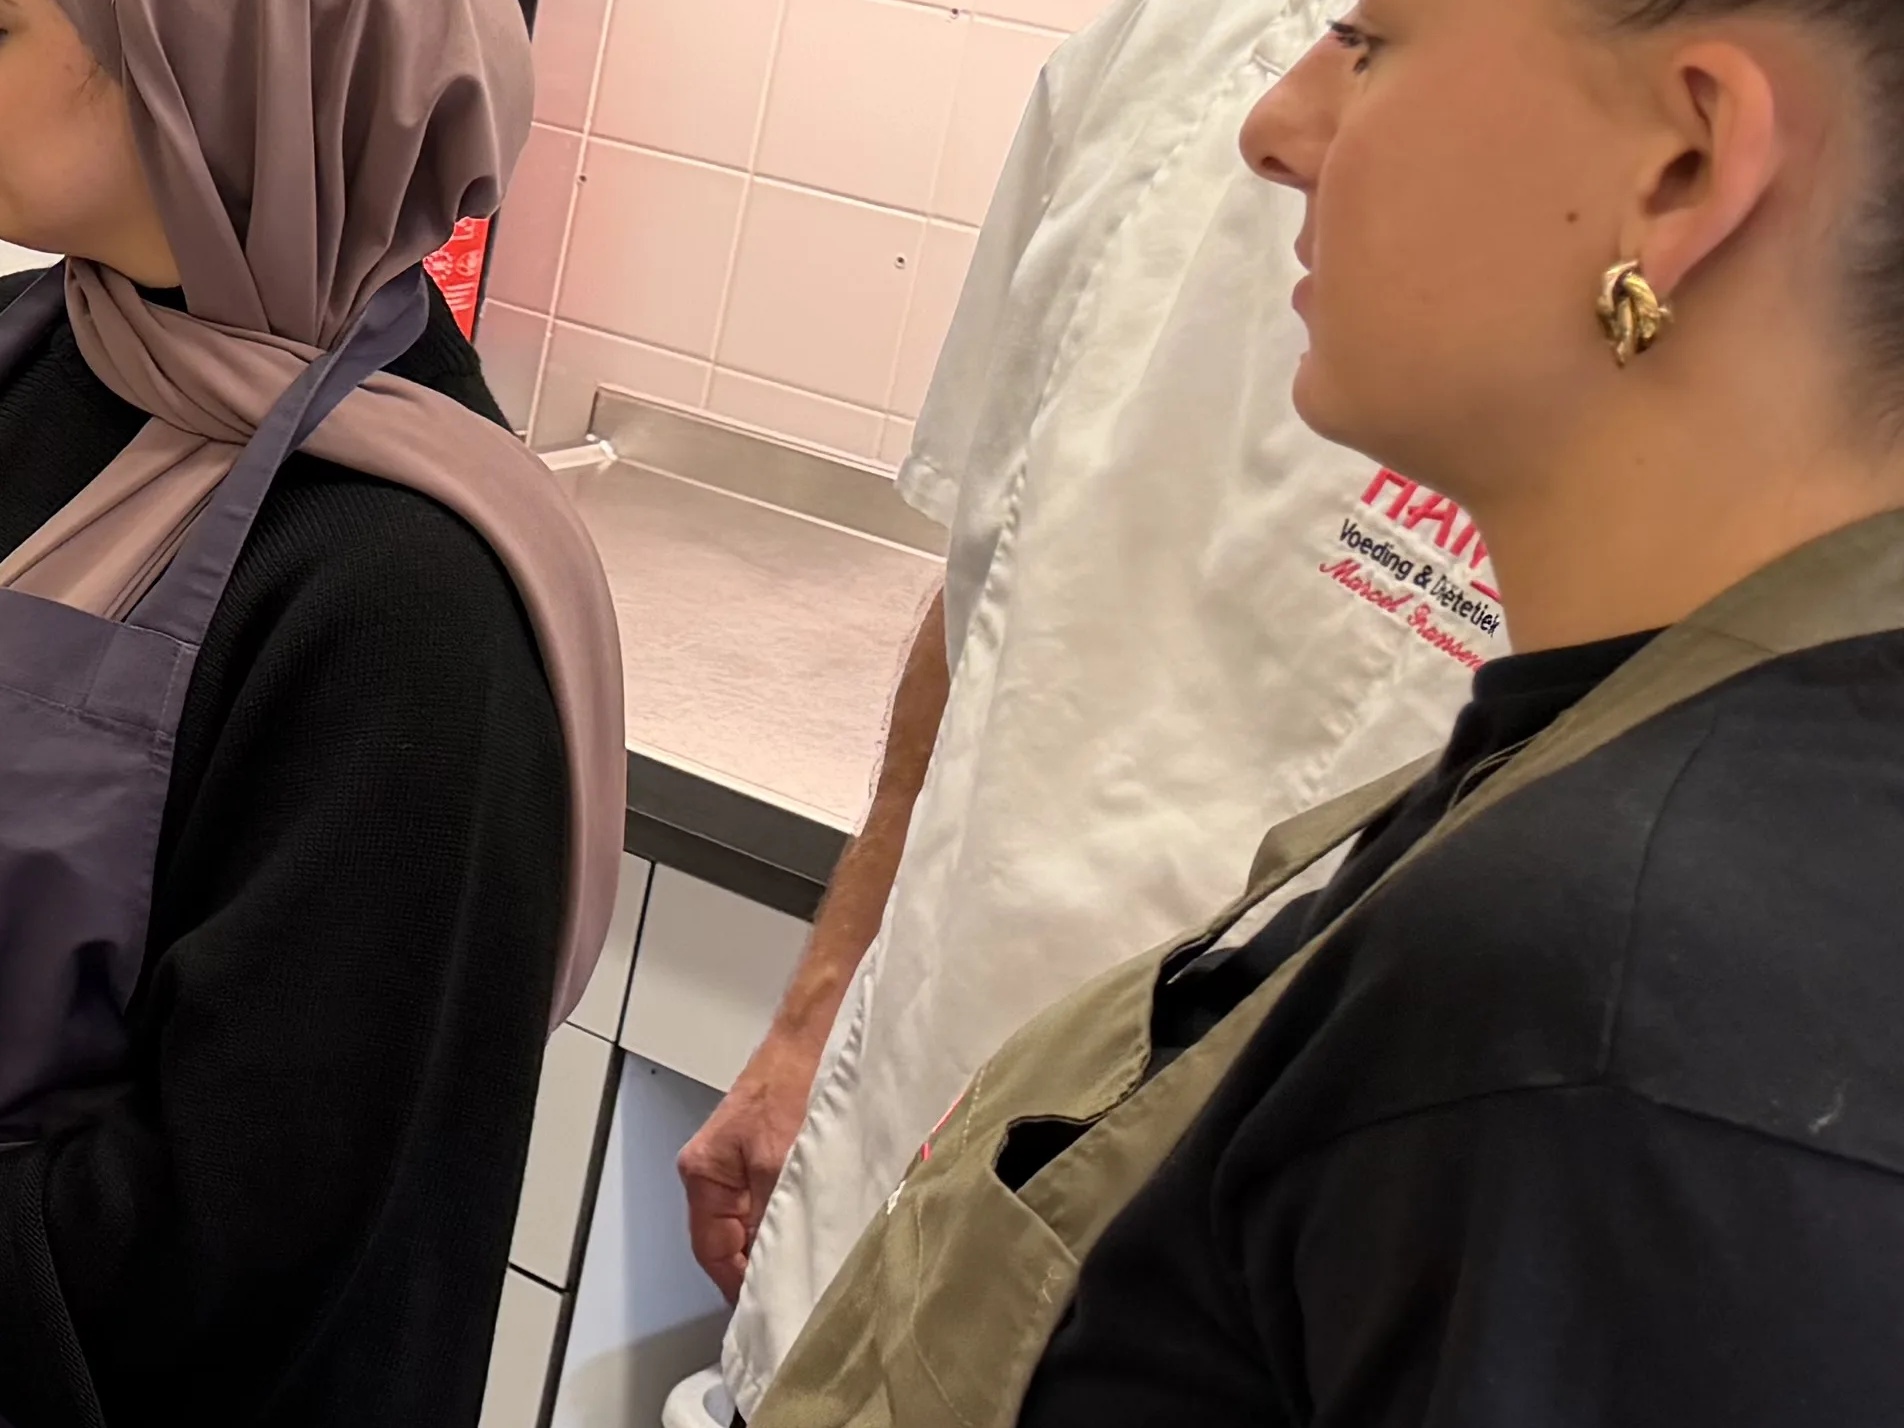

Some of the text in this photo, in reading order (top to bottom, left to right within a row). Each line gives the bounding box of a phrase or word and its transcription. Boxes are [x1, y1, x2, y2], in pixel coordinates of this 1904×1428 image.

[1340, 517, 1413, 580] Voeding
[1414, 564, 1433, 589] &
[1319, 558, 1414, 613] Marcel
